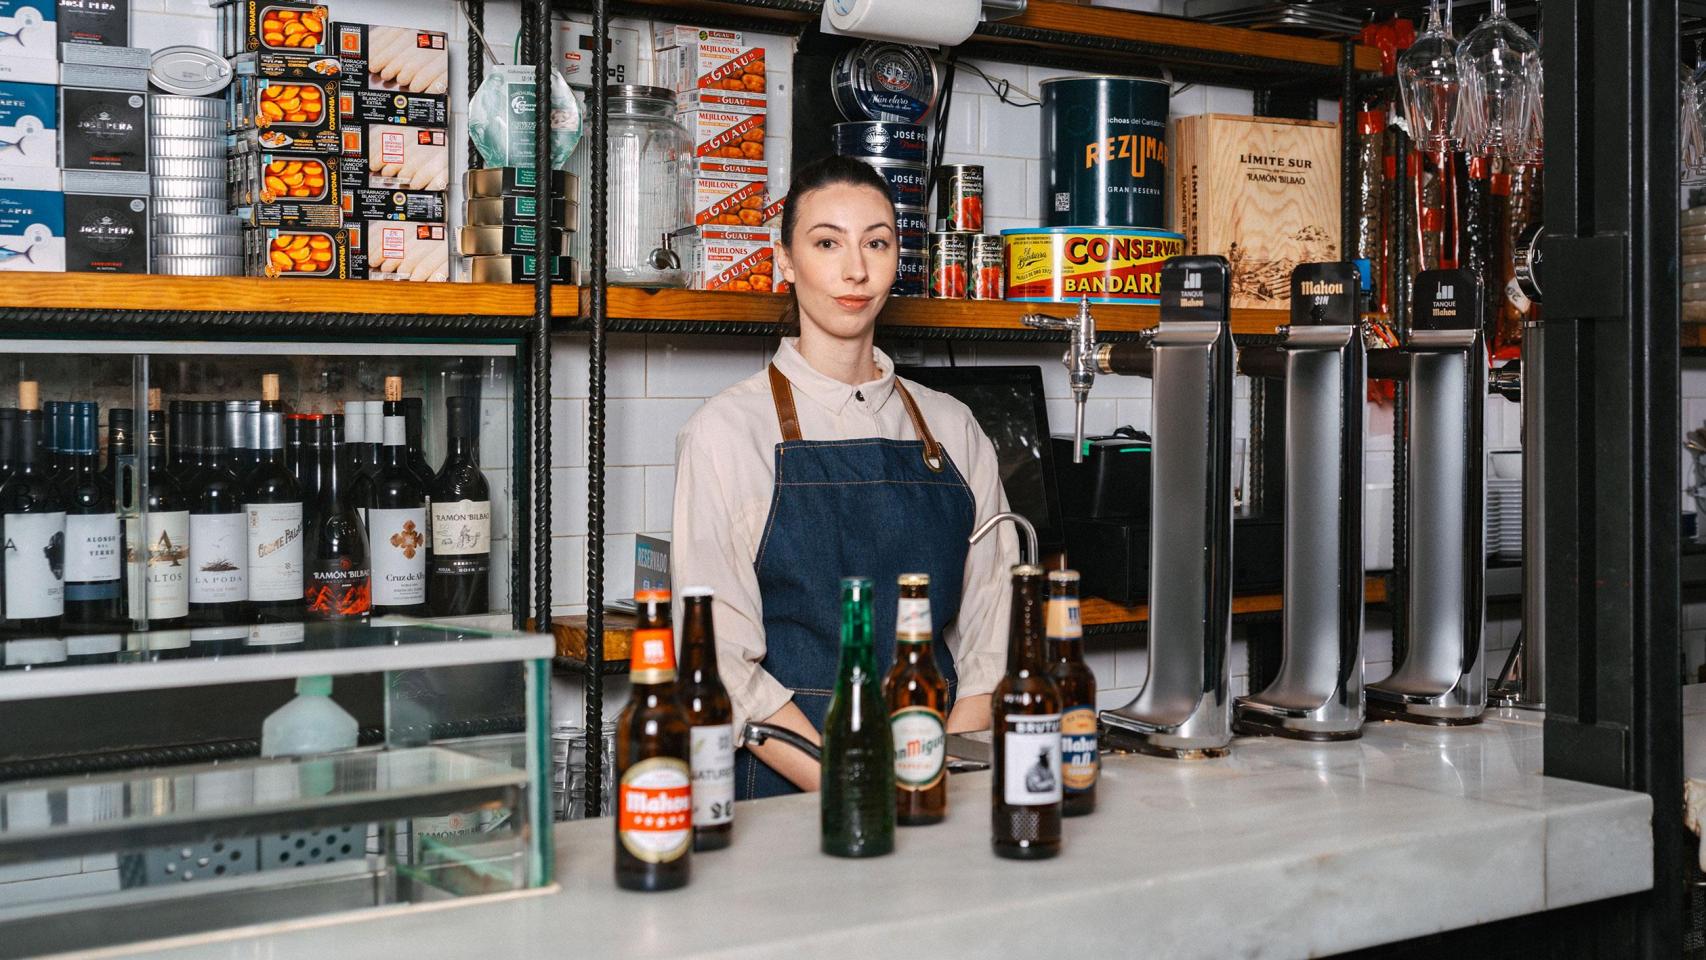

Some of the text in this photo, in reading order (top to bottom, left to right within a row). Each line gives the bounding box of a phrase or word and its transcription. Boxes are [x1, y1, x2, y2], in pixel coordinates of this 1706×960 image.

[893, 130, 916, 140] JOSÉ
[1240, 153, 1312, 169] LÍMITE SUR
[891, 174, 914, 184] JOSÉ
[1247, 173, 1306, 185] RAMÓN BILBAO
[1133, 187, 1161, 195] RESERVA
[1065, 236, 1181, 265] CONSERVAS
[1302, 280, 1344, 295] Mahou
[1180, 298, 1204, 307] Mahou
[1314, 295, 1329, 306] SIN
[1432, 308, 1456, 317] Mahou
[637, 546, 668, 574] RESERVADO
[313, 570, 347, 579] RAMÓN
[386, 573, 406, 582] Cruz
[407, 572, 415, 581] de
